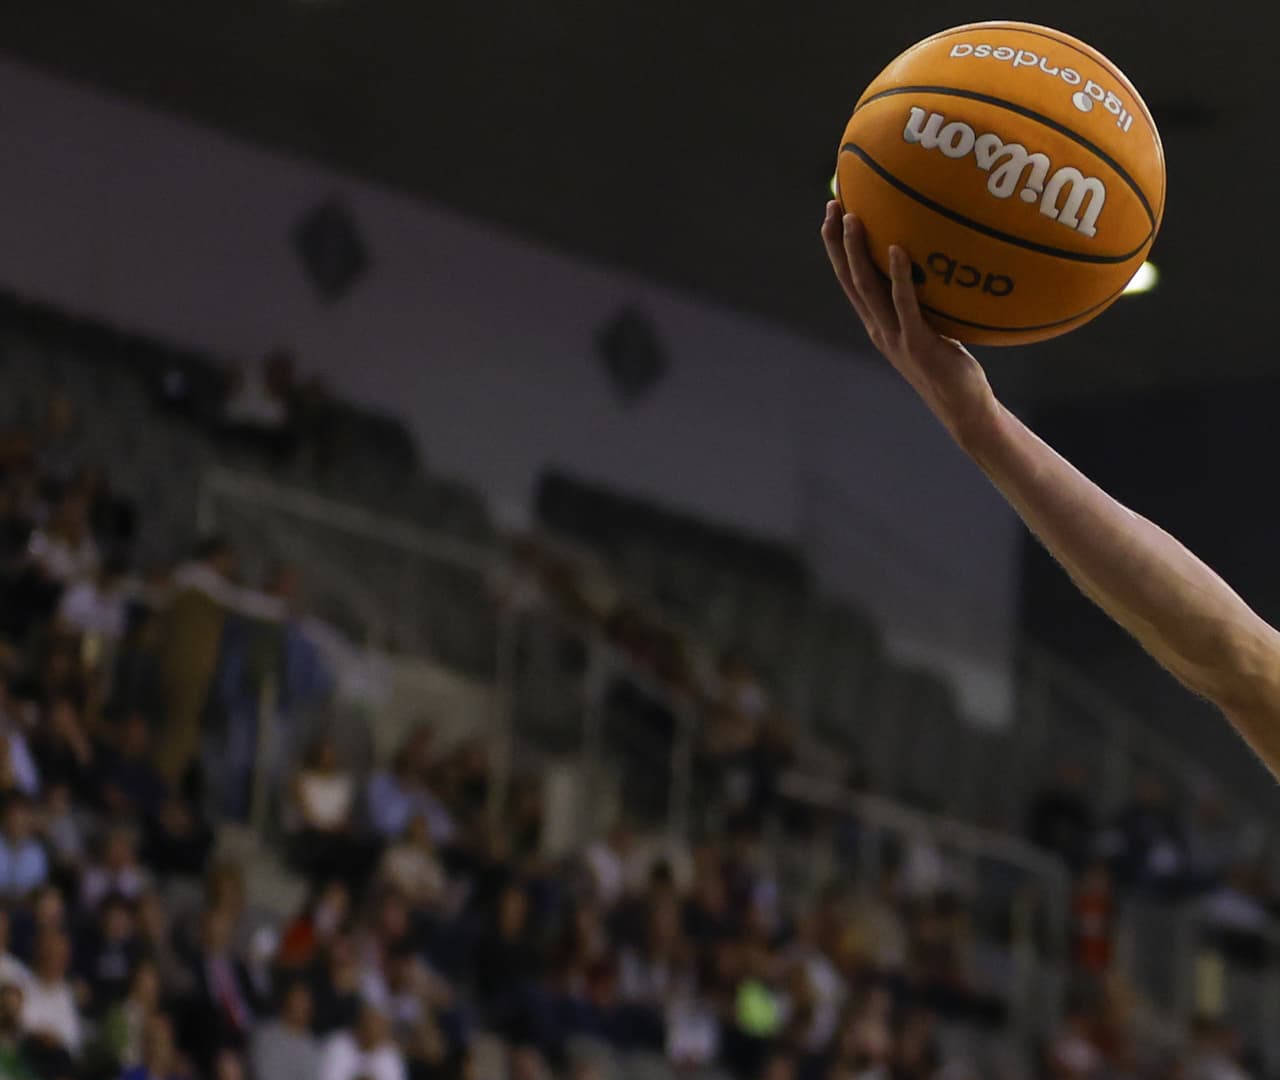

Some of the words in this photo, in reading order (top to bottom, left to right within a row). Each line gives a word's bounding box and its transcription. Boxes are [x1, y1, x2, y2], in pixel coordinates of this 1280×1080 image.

[949, 42, 1082, 86] endesa
[1083, 79, 1135, 134] liga
[902, 106, 1107, 239] Wilson
[926, 251, 1016, 298] acb
